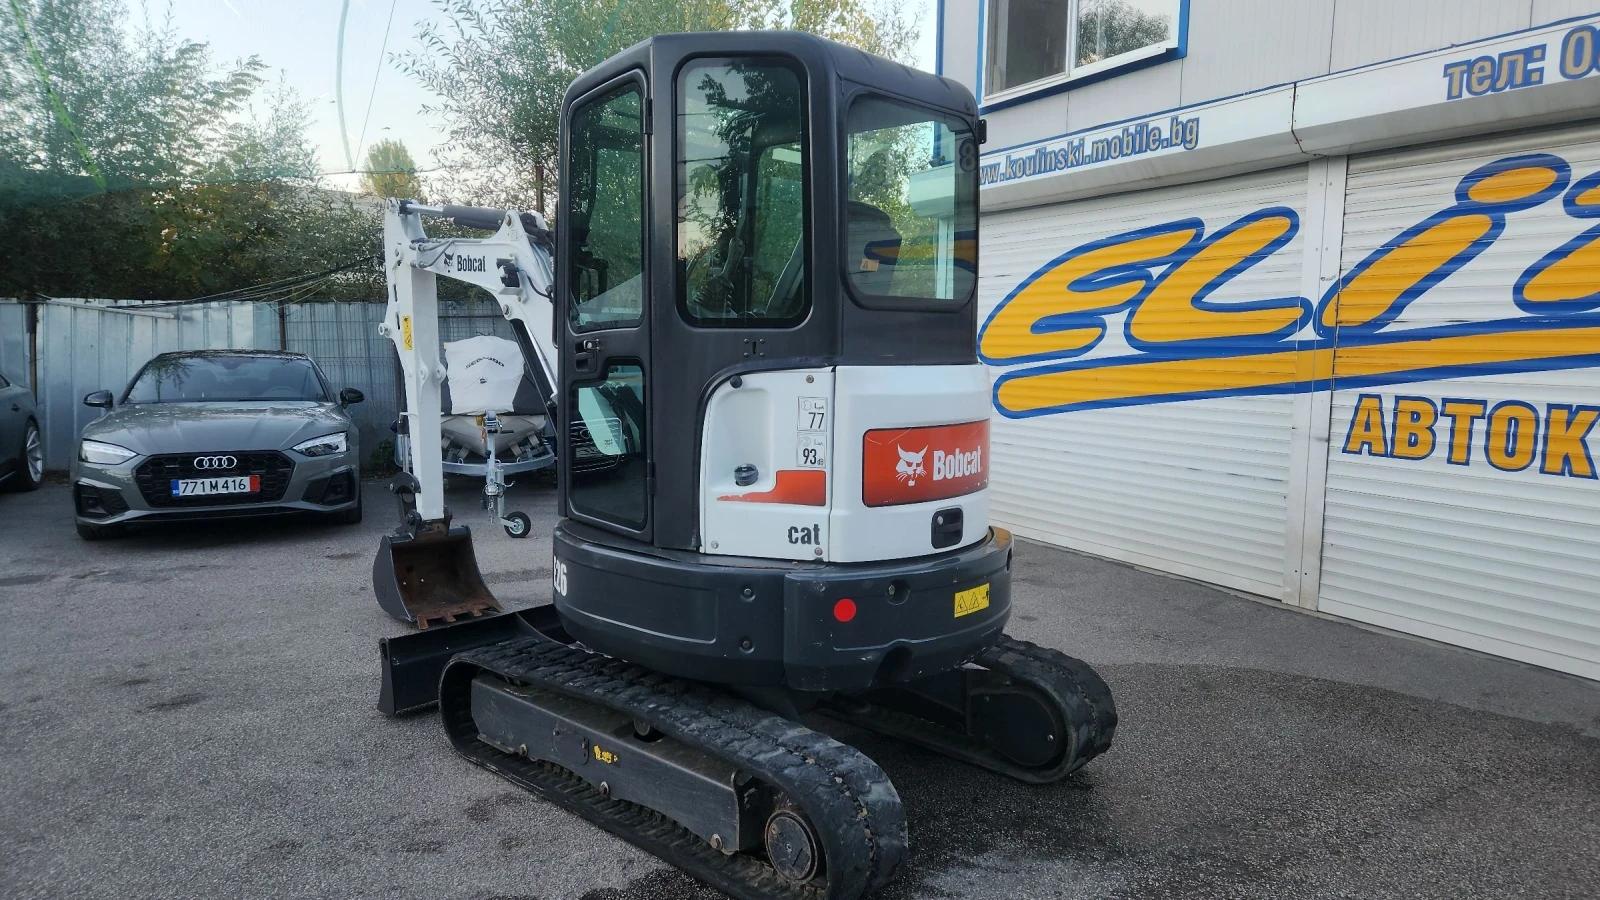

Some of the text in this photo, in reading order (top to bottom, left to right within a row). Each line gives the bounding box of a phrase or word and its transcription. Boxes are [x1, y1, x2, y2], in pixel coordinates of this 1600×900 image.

[1443, 24, 1600, 101] тел: 0
[457, 254, 486, 272] Bobcat
[808, 411, 825, 429] 77
[802, 447, 817, 465] 93
[932, 445, 982, 481] Bobcat
[787, 523, 821, 546] cat
